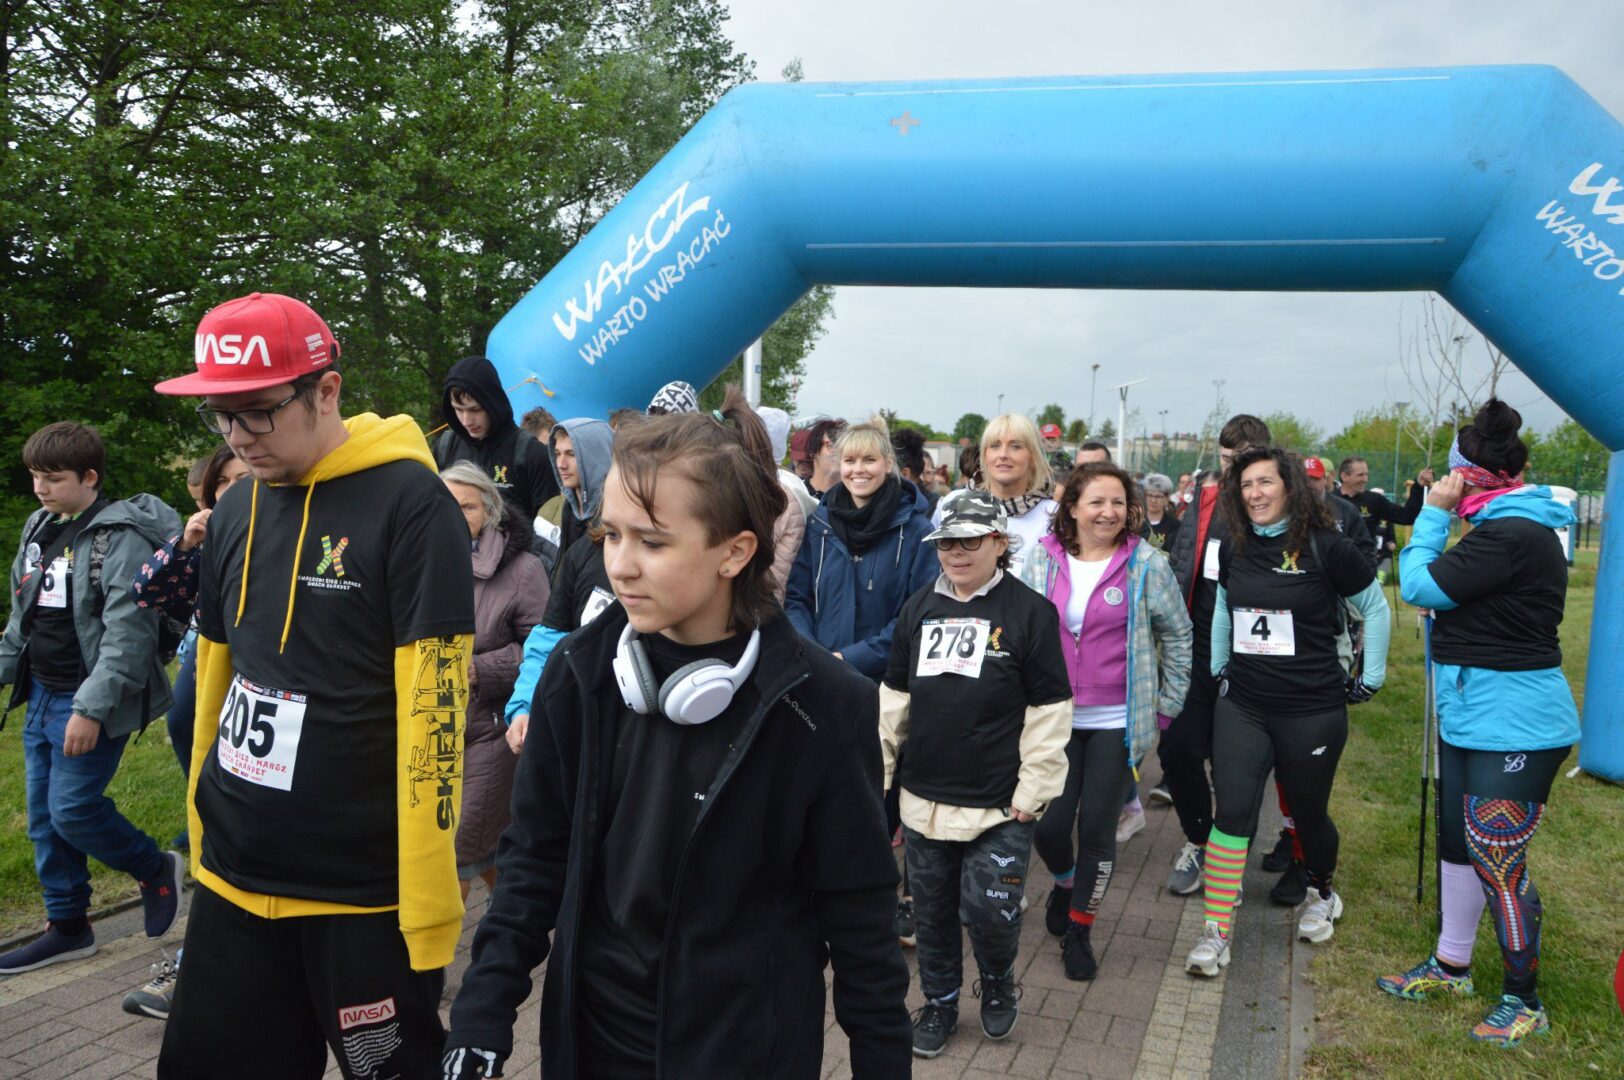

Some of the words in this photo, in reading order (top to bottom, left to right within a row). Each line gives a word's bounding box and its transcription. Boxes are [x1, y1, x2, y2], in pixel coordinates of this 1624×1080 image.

[552, 181, 711, 341] WAŁCZ
[1536, 199, 1624, 280] WARTO
[578, 295, 648, 366] WARTO
[643, 208, 731, 303] WRACAĆ
[926, 625, 977, 659] 278
[1251, 615, 1271, 641] 4
[220, 684, 278, 759] 205
[986, 888, 1009, 900] SUPER
[343, 1004, 392, 1024] NASA
